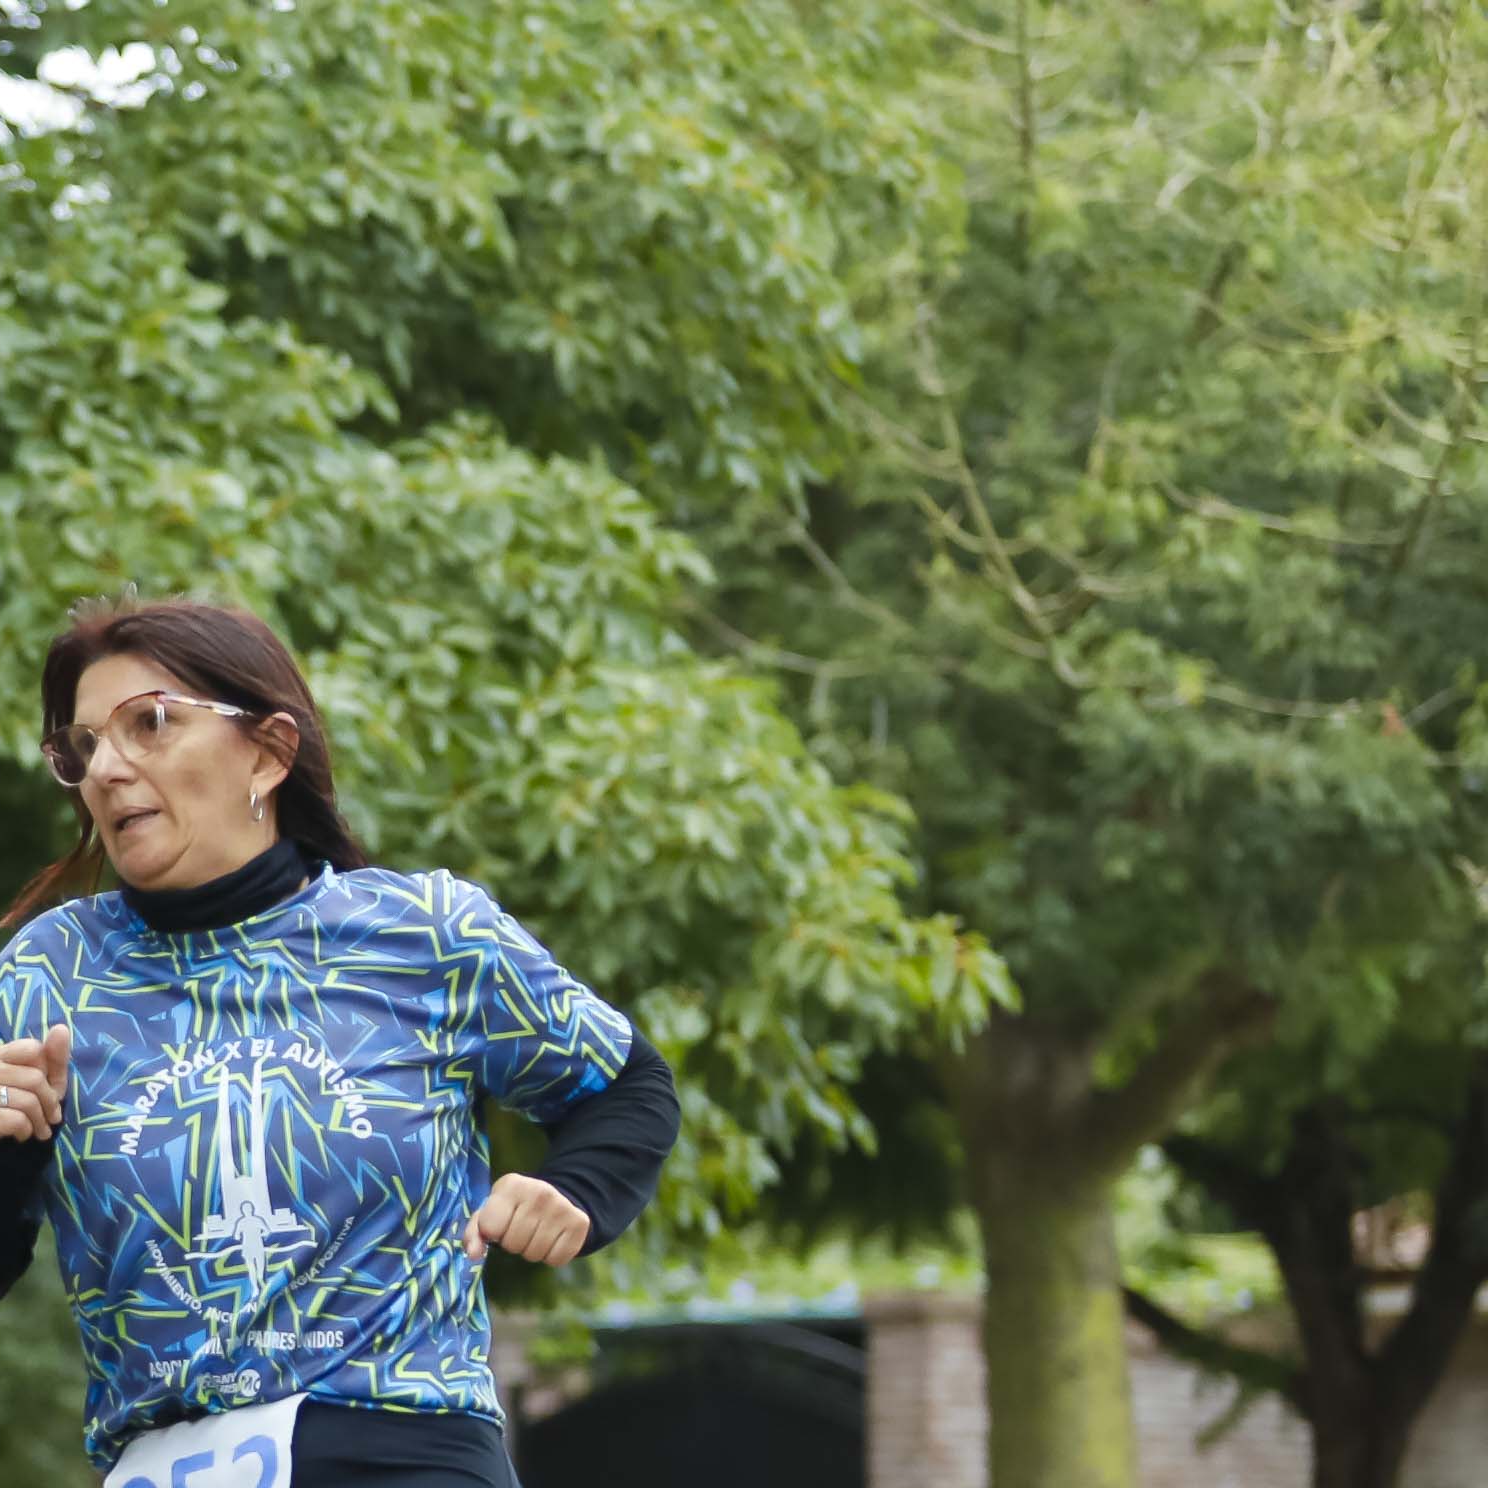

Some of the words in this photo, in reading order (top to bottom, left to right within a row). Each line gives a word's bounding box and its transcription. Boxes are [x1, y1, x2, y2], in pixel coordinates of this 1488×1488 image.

[224, 1040, 241, 1062] X
[250, 1039, 277, 1058] EL
[282, 1042, 372, 1139] AUTISMO
[247, 1330, 296, 1350] PADRES
